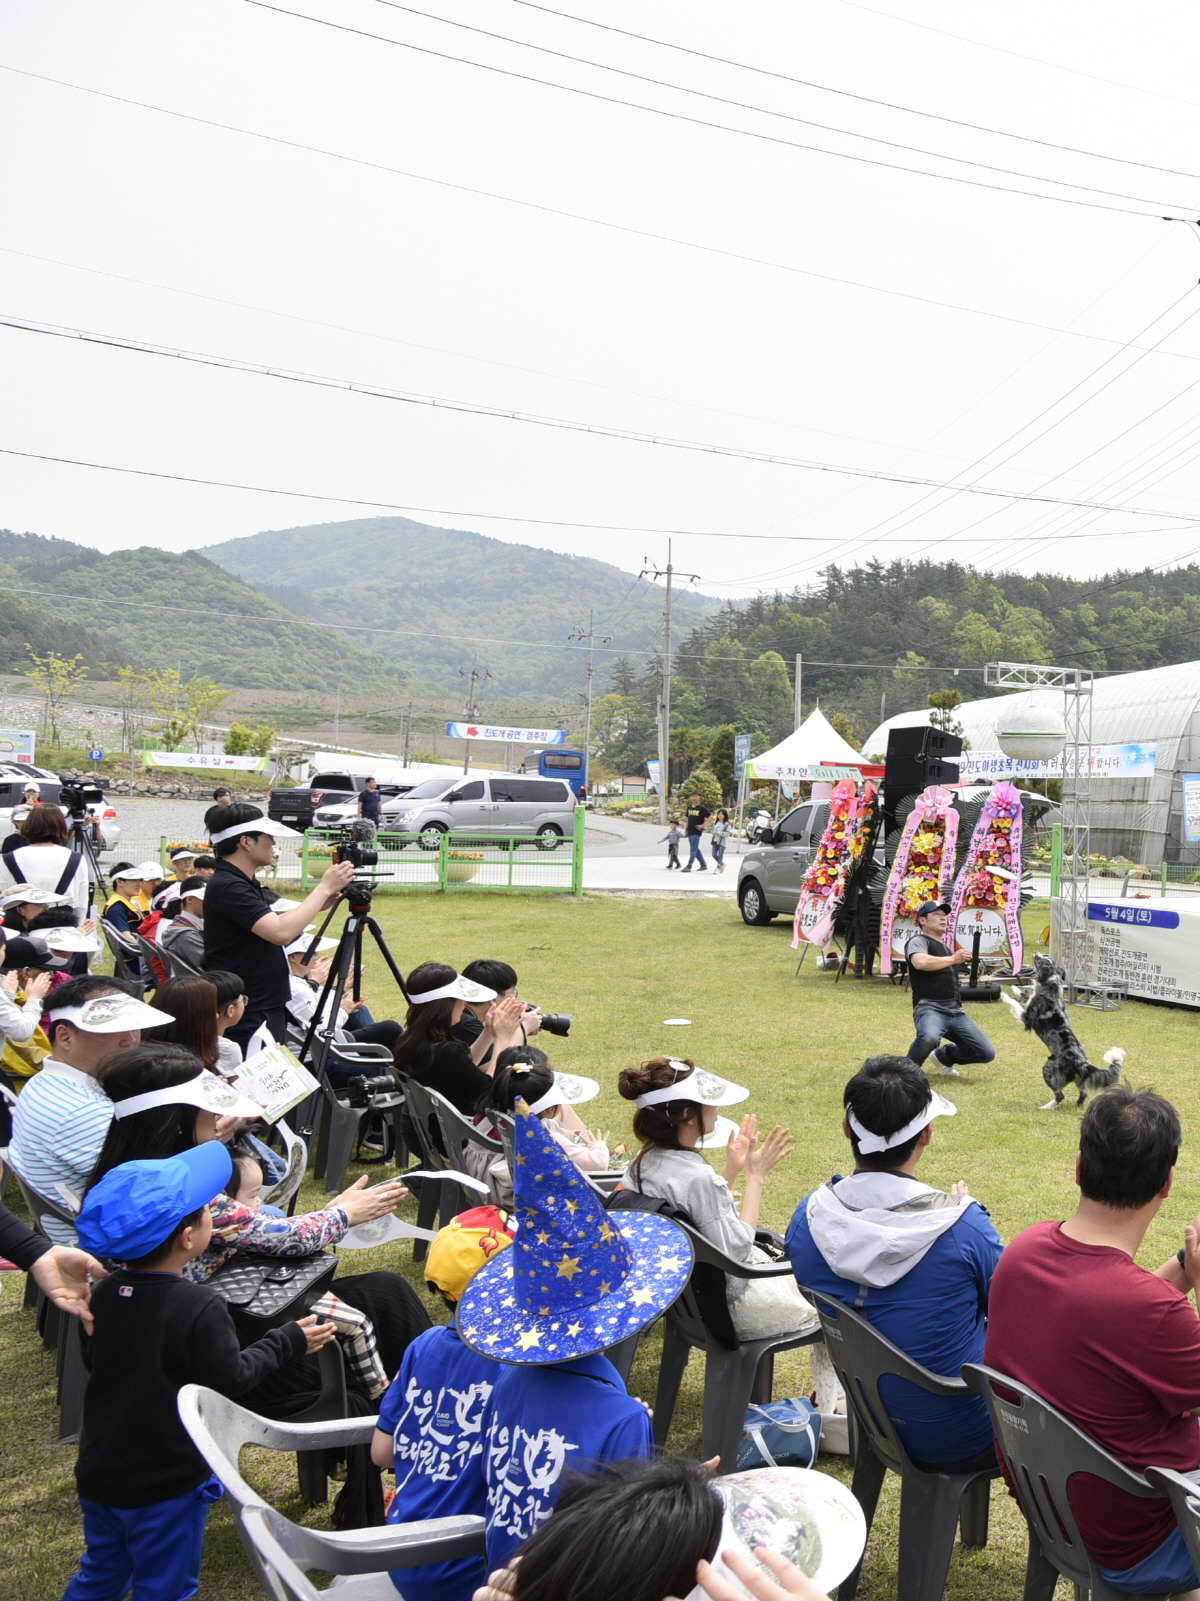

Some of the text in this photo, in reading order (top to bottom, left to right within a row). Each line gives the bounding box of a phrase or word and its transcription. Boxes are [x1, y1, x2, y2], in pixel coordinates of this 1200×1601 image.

[92, 750, 100, 760] P
[775, 766, 813, 778] 주차안
[1105, 907, 1152, 924] 5월 4일 (토)
